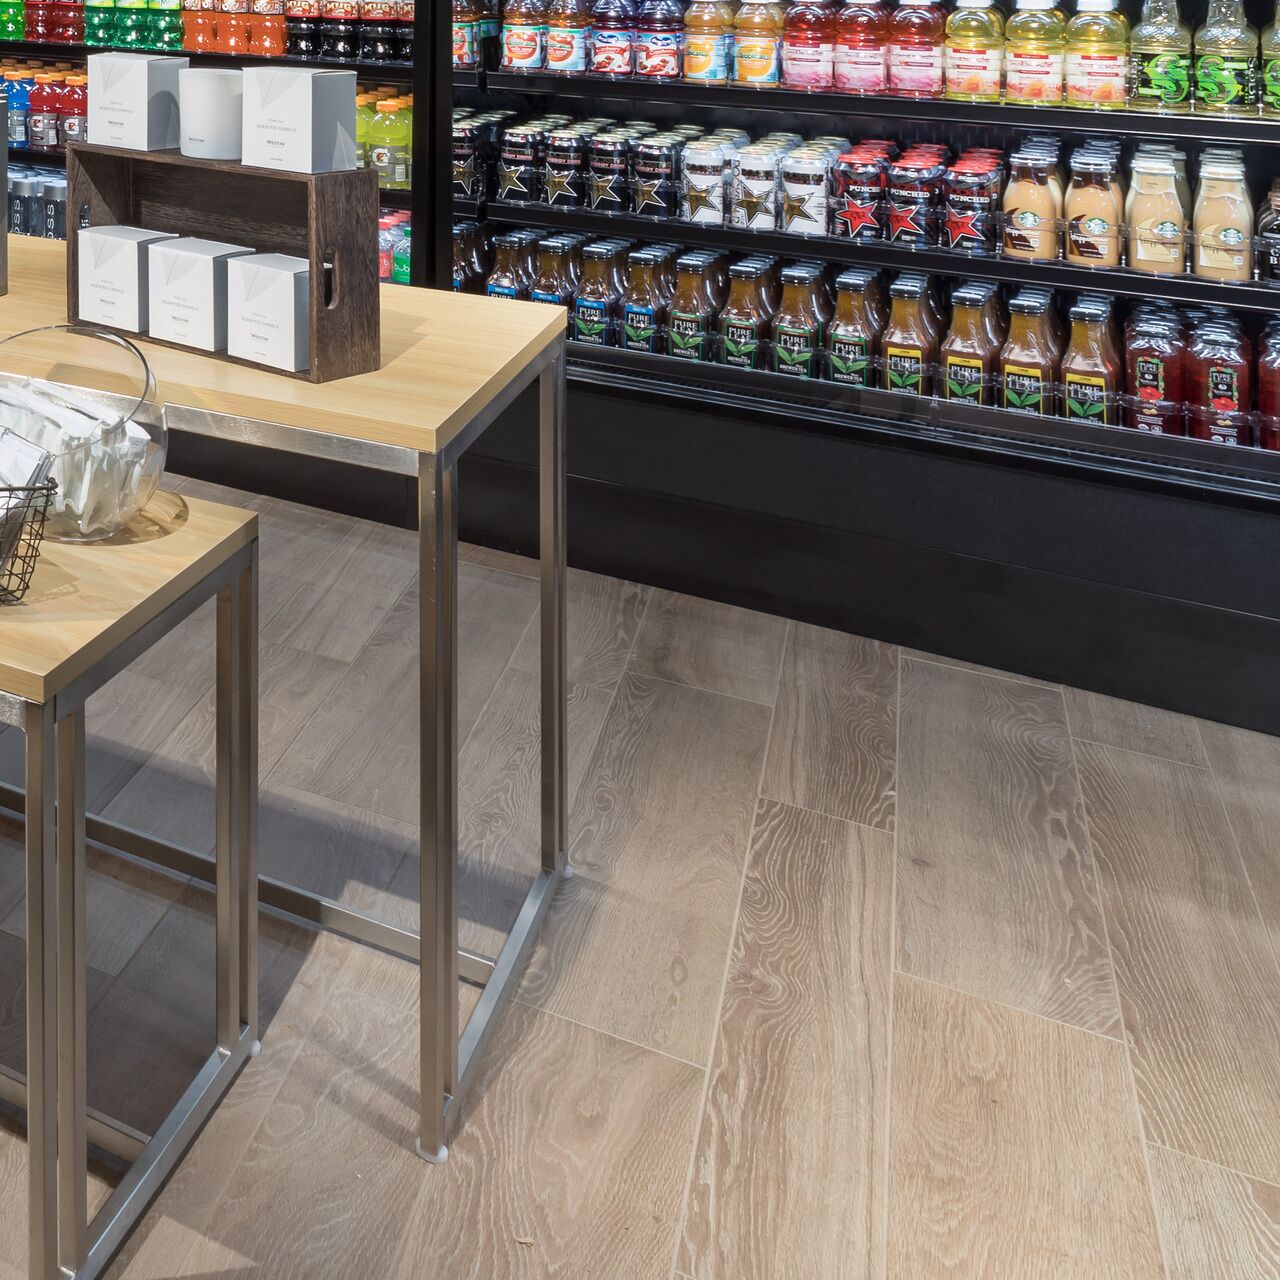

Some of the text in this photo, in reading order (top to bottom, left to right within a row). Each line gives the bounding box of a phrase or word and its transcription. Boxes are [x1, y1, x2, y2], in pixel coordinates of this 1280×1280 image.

[890, 188, 929, 198] PUNCHED
[949, 193, 990, 204] PUNCHED
[579, 307, 602, 317] PURE
[628, 313, 650, 322] PURE
[674, 319, 697, 329] PURE
[728, 326, 752, 336] PURE
[781, 334, 805, 344] PURE
[835, 343, 862, 353] PURE
[891, 356, 917, 365] PURE
[951, 365, 978, 375] PURE
[1008, 375, 1036, 384] PURE
[1070, 384, 1100, 394] PURE
